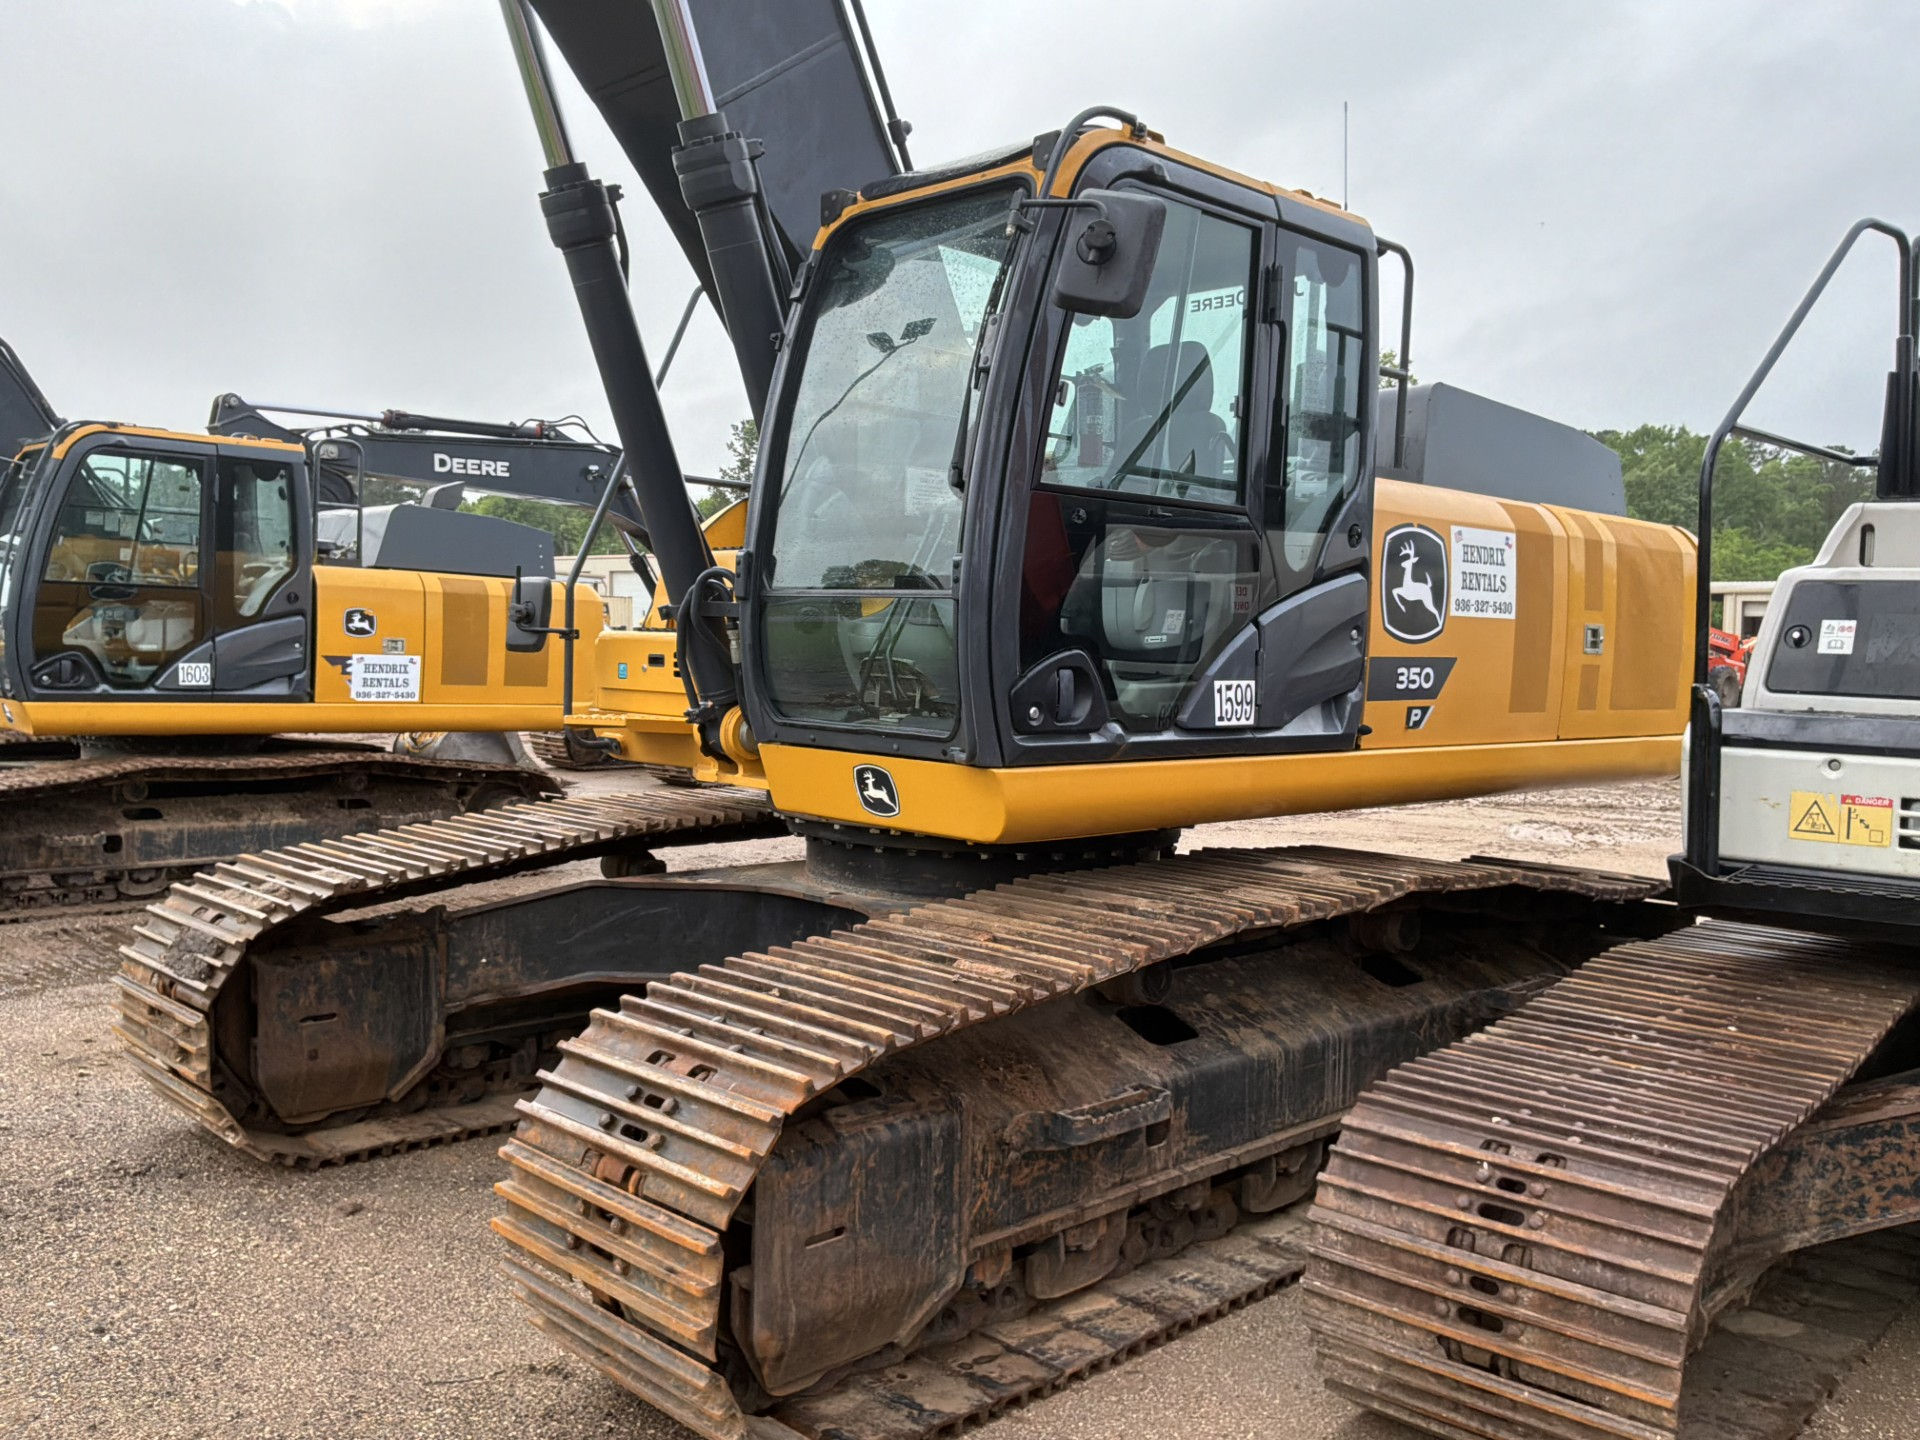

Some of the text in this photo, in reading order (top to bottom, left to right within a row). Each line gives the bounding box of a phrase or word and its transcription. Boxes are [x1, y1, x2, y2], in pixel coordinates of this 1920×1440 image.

[433, 452, 510, 477] DEERE
[1462, 543, 1506, 567] HENDRIX
[1461, 571, 1507, 593] RENTALS
[1454, 598, 1513, 615] 936-327-5430
[180, 665, 209, 683] 1603
[363, 663, 409, 674] HENDRIX
[362, 677, 409, 688] RENTALS
[1395, 667, 1435, 690] 350
[355, 691, 416, 699] 936-327-5430
[1216, 683, 1253, 722] 1599
[1408, 709, 1422, 727] P
[1854, 797, 1890, 807] DANGER
